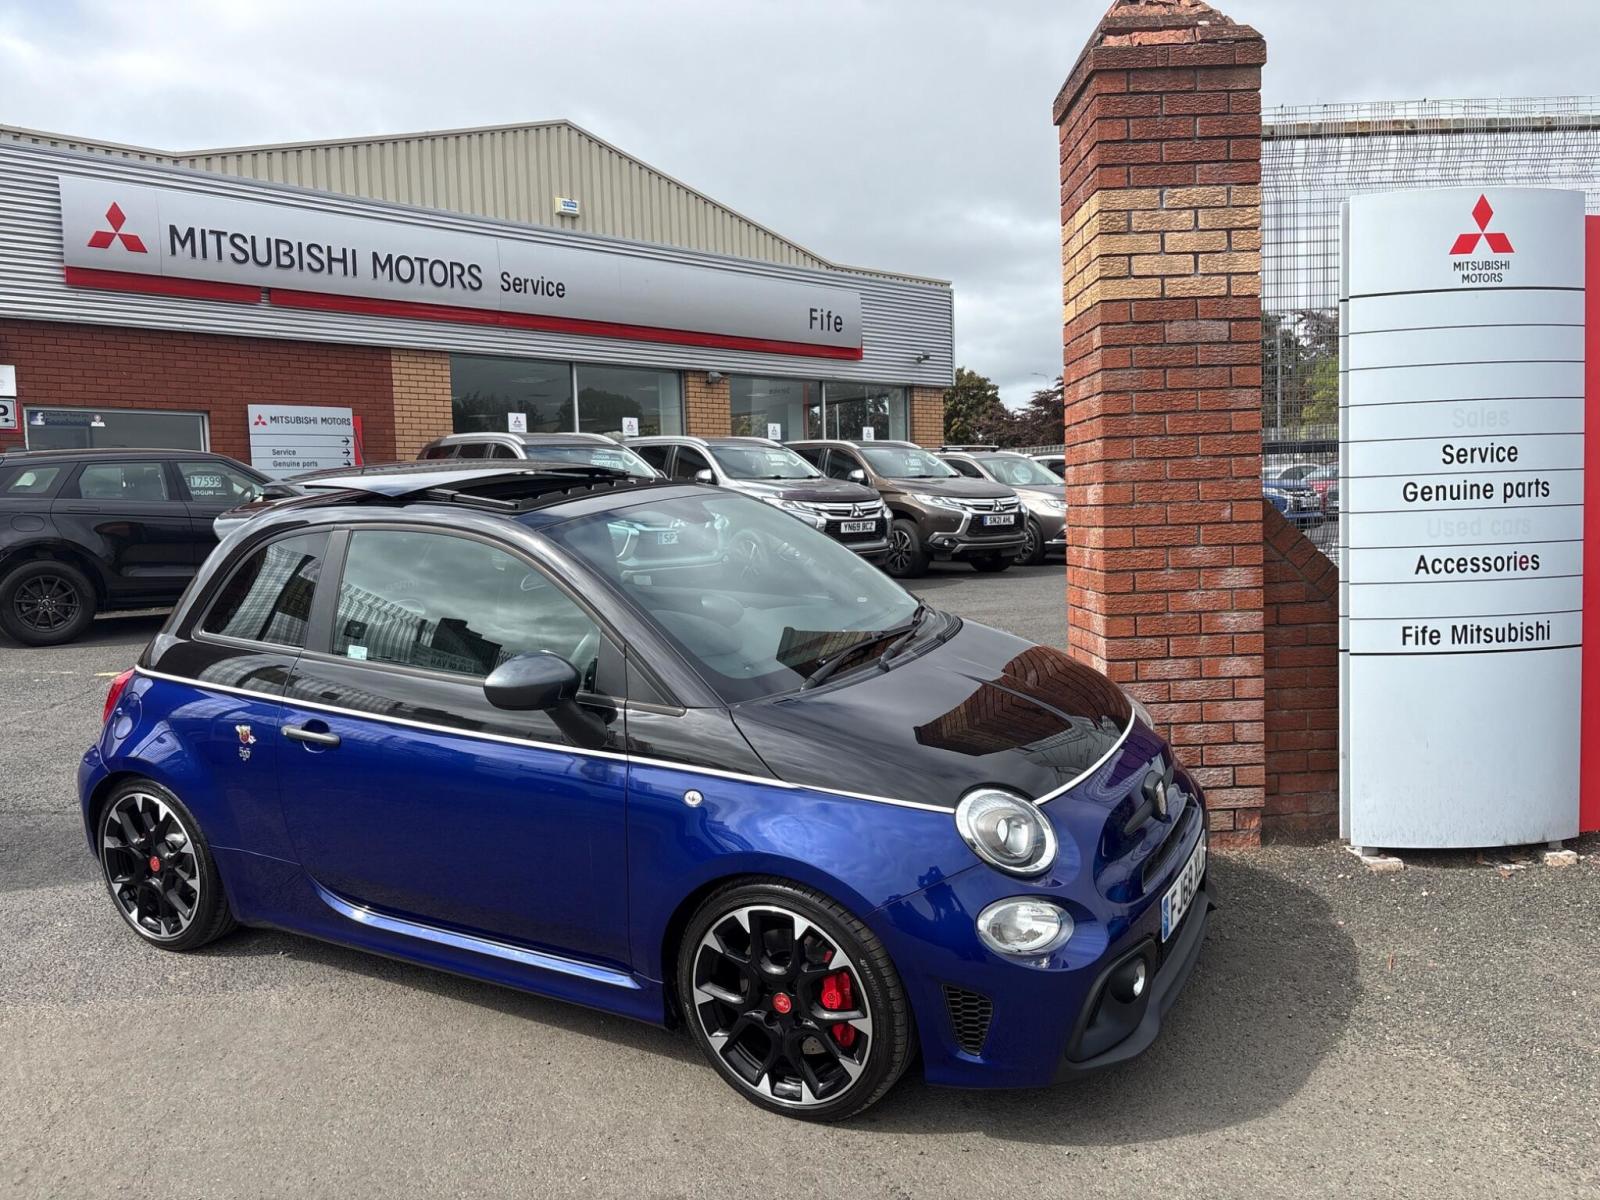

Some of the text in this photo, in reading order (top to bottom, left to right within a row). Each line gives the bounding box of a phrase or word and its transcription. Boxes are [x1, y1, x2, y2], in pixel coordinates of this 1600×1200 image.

[168, 223, 484, 292] MITSUBISHI MOTORS
[1453, 260, 1511, 272] MITSUBISHI
[500, 270, 567, 299] Service
[1461, 272, 1504, 284] MOTORS
[808, 306, 844, 334] Fife
[269, 415, 352, 426] MITSUBISHI MOTORS
[1452, 407, 1511, 429] Sales
[271, 448, 297, 456] Service
[1441, 442, 1519, 465] Service
[272, 460, 318, 469] Genuine parts
[1402, 477, 1551, 504] Genuine parts
[1426, 515, 1532, 539] Used cars
[1414, 550, 1541, 576] Accessories
[1401, 619, 1552, 647] Fife Mitsubishi
